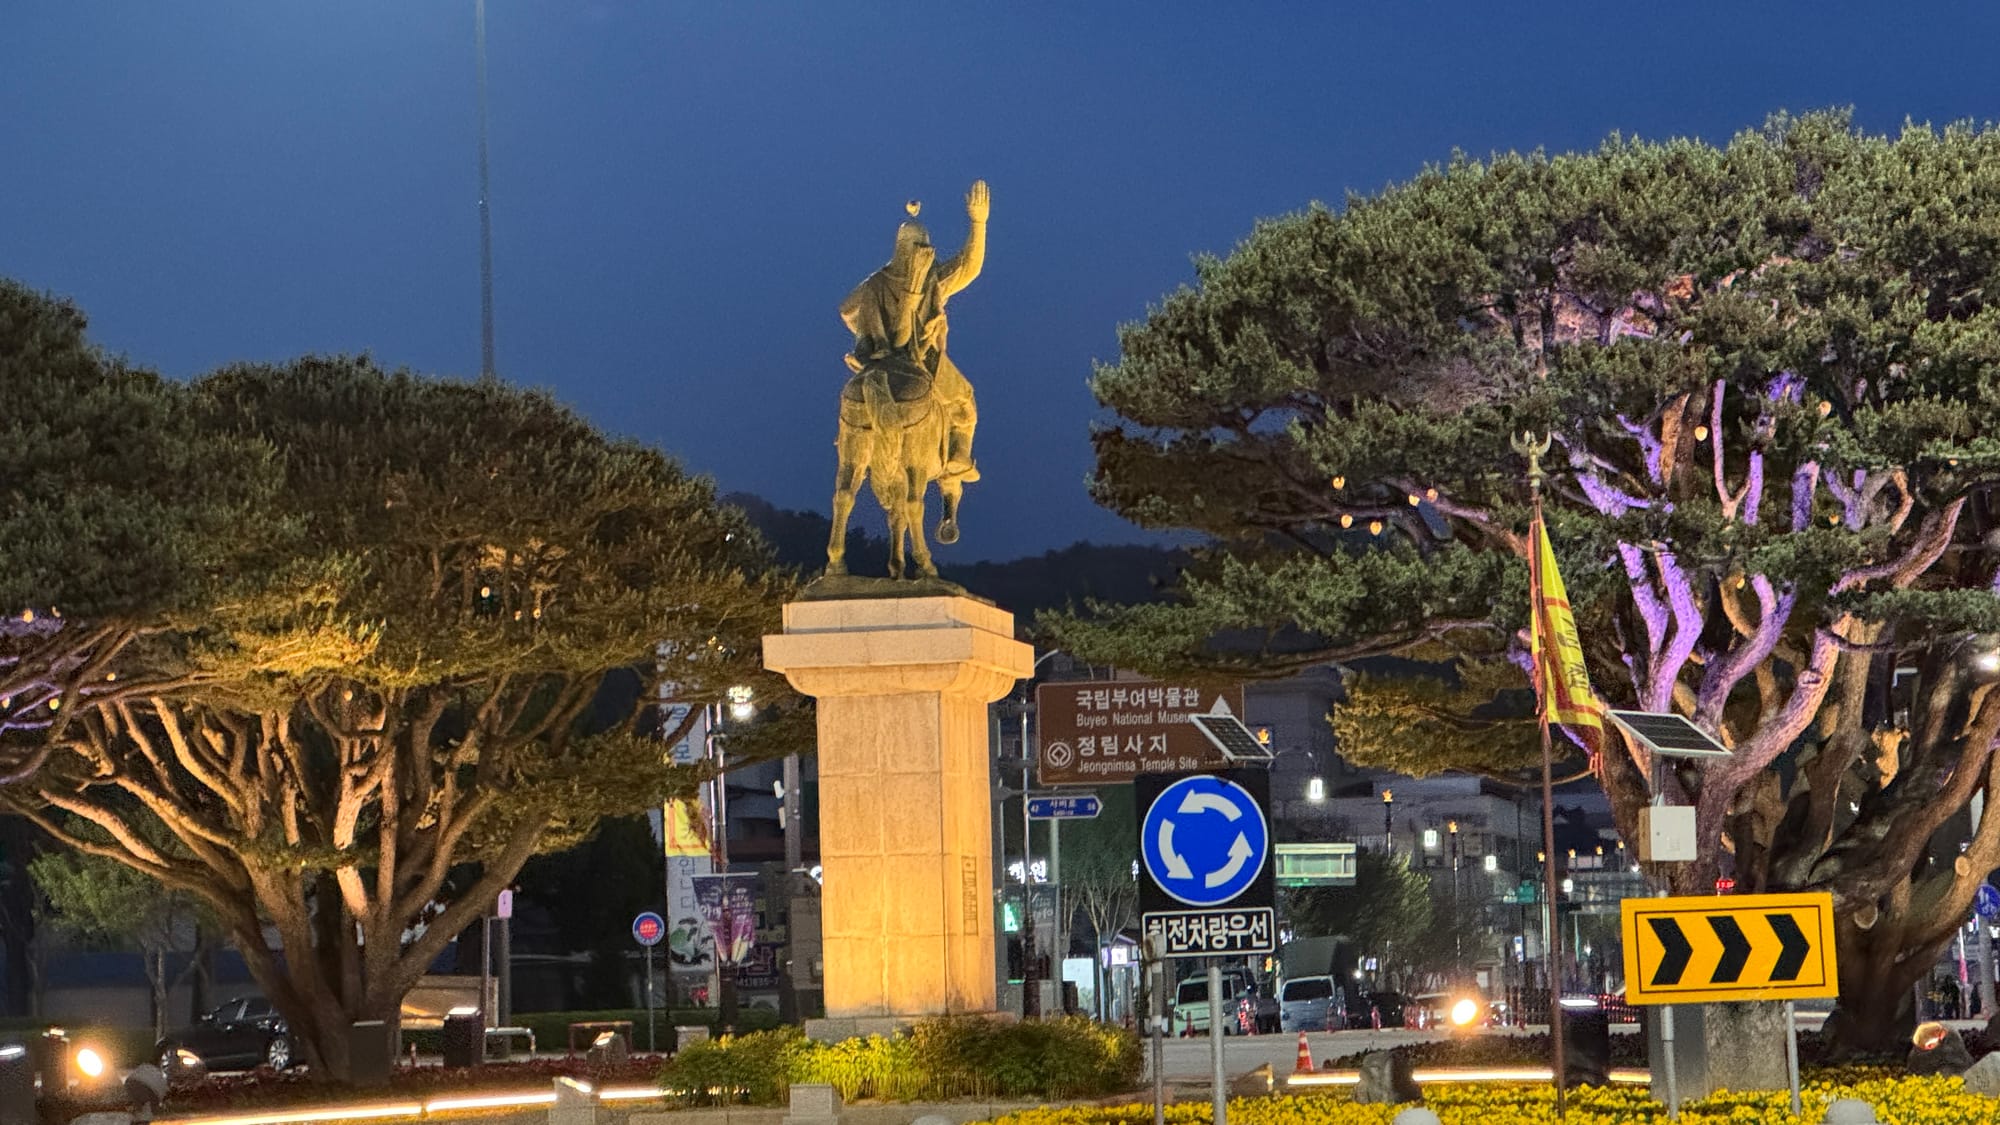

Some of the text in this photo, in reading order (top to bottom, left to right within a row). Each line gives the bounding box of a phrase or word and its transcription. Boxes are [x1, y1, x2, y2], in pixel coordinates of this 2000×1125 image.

[1076, 687, 1199, 711] 국립부여박물관
[1076, 710, 1194, 729] Buyeo National Museu
[1077, 733, 1167, 757] 정림사지
[1077, 756, 1198, 775] Jeongnimsa Temple Site
